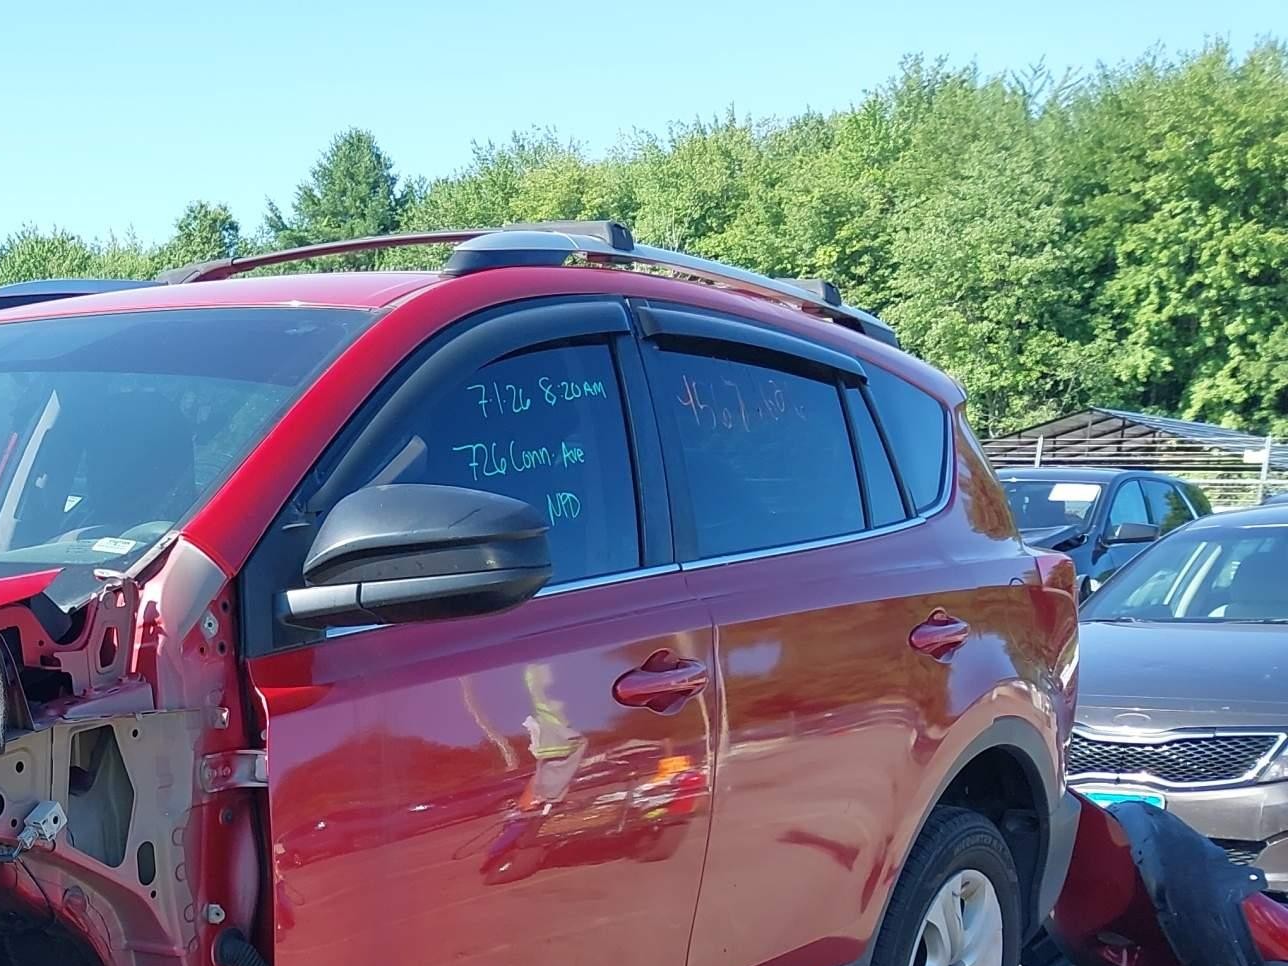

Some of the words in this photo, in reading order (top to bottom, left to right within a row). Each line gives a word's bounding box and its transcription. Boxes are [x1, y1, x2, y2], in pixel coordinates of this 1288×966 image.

[452, 443, 507, 480] 726
[561, 441, 585, 468] Ave
[546, 492, 581, 526] NPD
